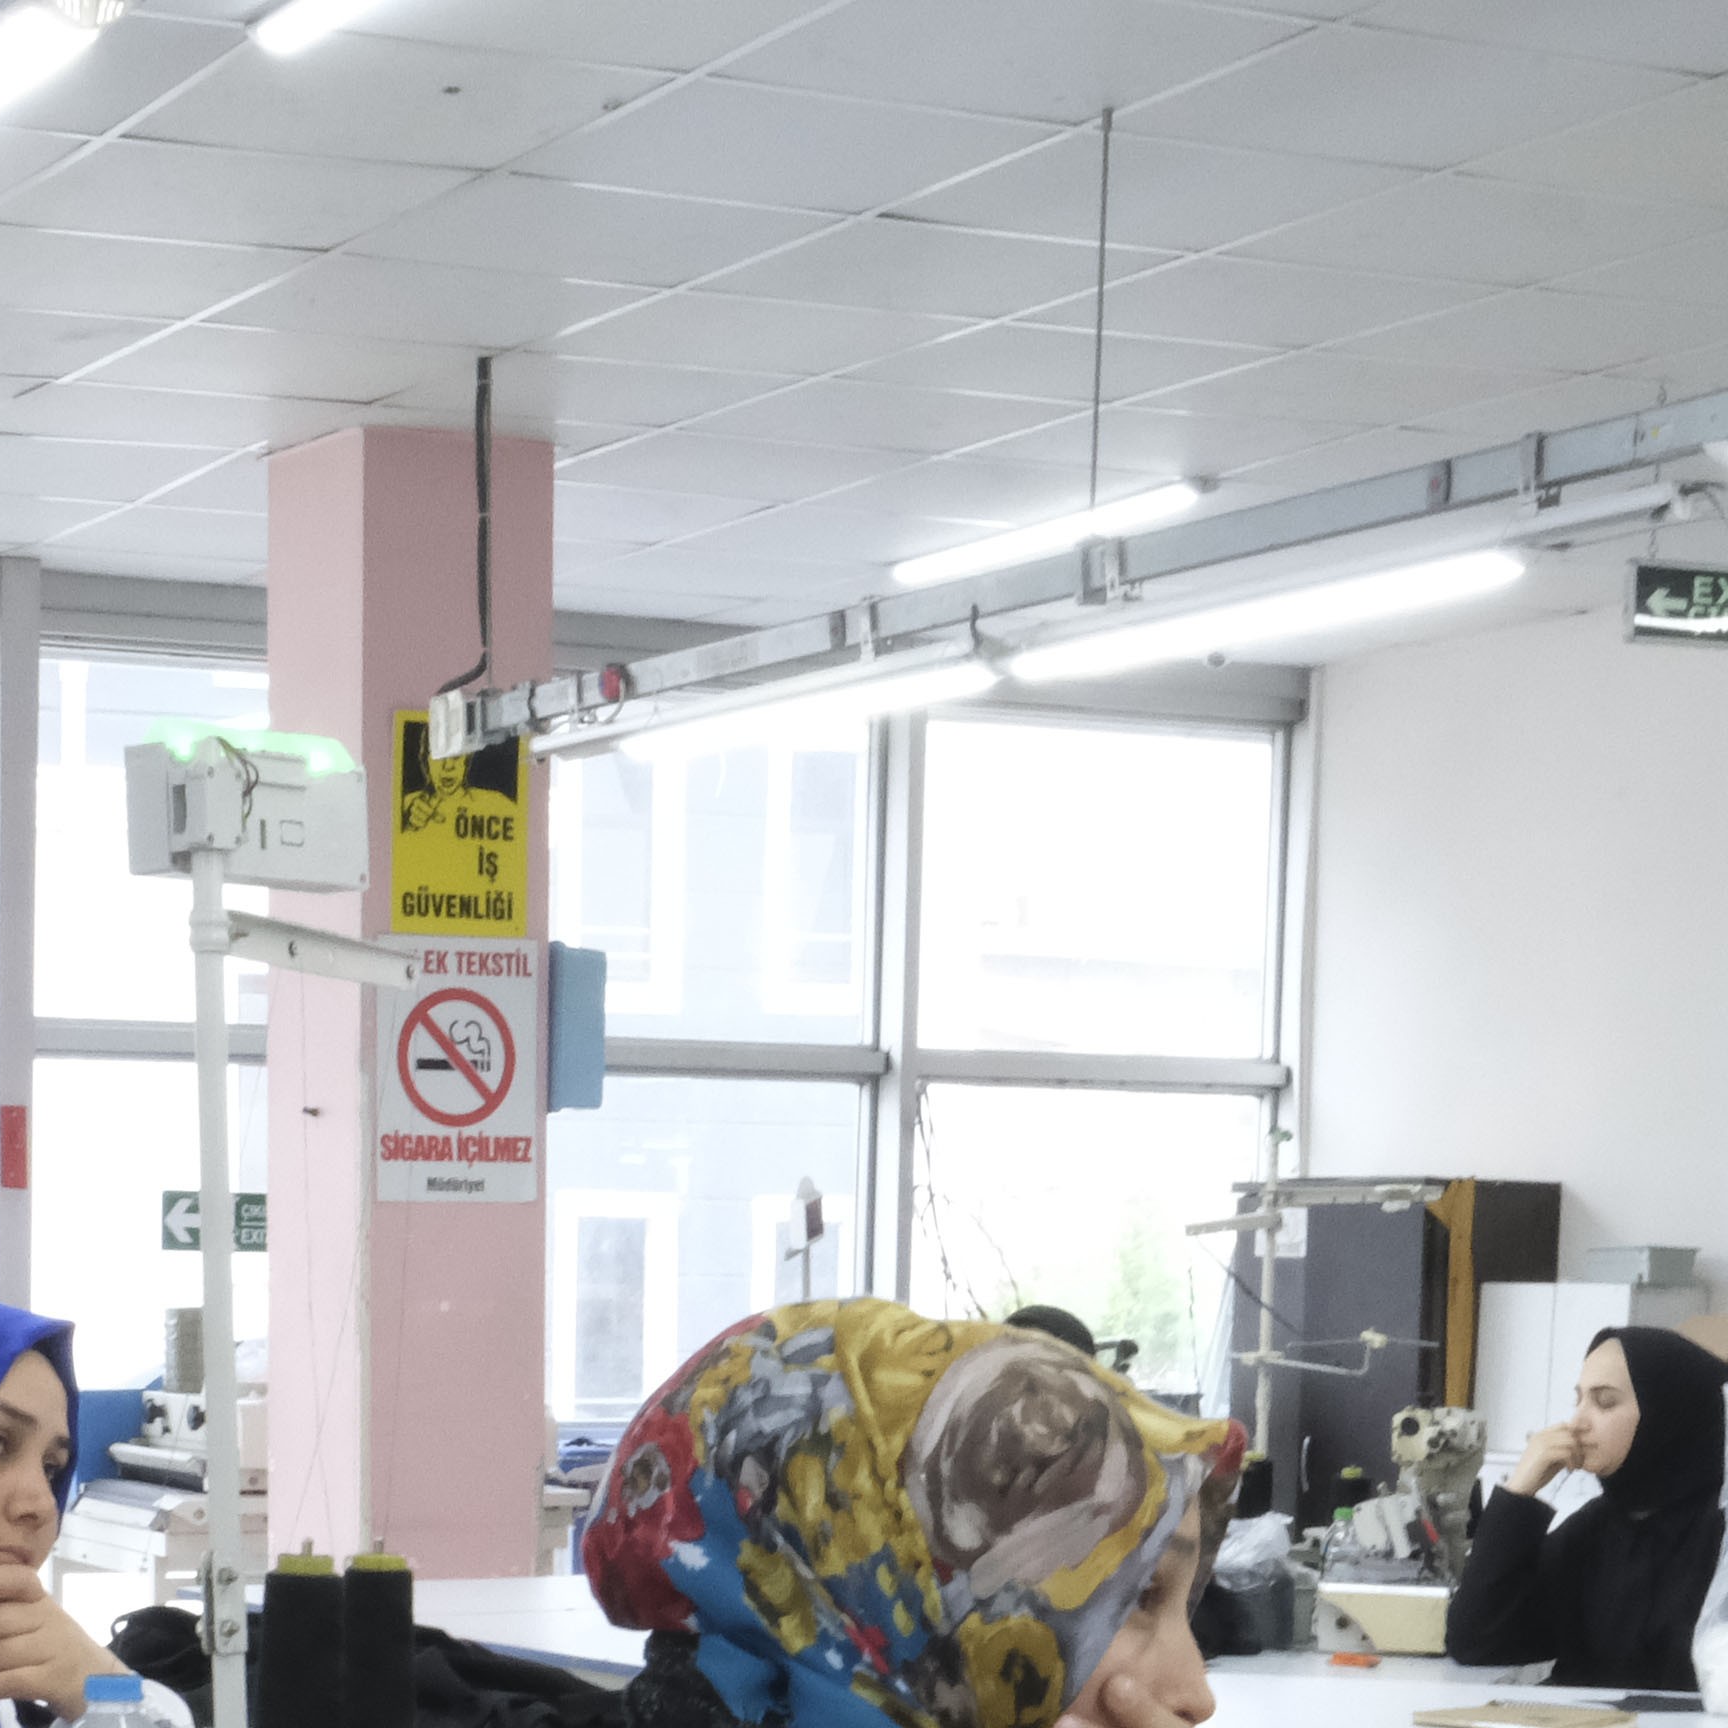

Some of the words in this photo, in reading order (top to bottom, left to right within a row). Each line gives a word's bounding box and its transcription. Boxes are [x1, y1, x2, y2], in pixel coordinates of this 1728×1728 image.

[454, 805, 515, 842] ÖNCE
[477, 844, 499, 884] İŞ
[401, 884, 514, 922] GÜVENLİĞİ
[423, 949, 449, 975] EK
[454, 948, 533, 977] TEKSTİL
[380, 1130, 454, 1162] SİGARA
[457, 1130, 533, 1168] İÇİLMEZ
[239, 1203, 266, 1222] ÇIK
[239, 1227, 266, 1245] EXI
